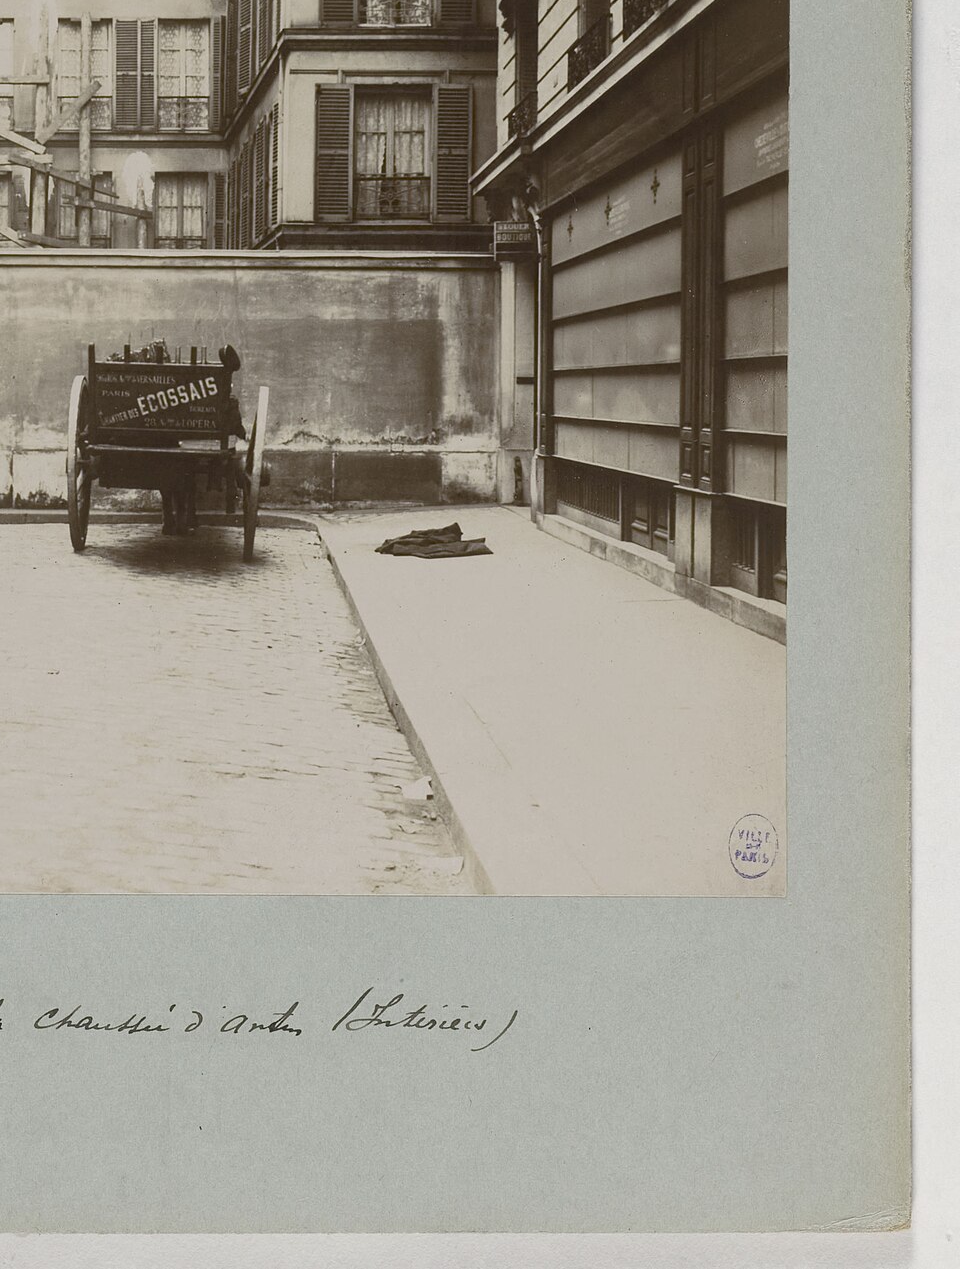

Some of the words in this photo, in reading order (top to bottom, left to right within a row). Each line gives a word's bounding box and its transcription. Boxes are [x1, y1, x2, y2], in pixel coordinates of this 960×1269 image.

[496, 233, 531, 241] BOUTIQUE
[101, 390, 131, 398] PARIS
[128, 407, 140, 419] DES
